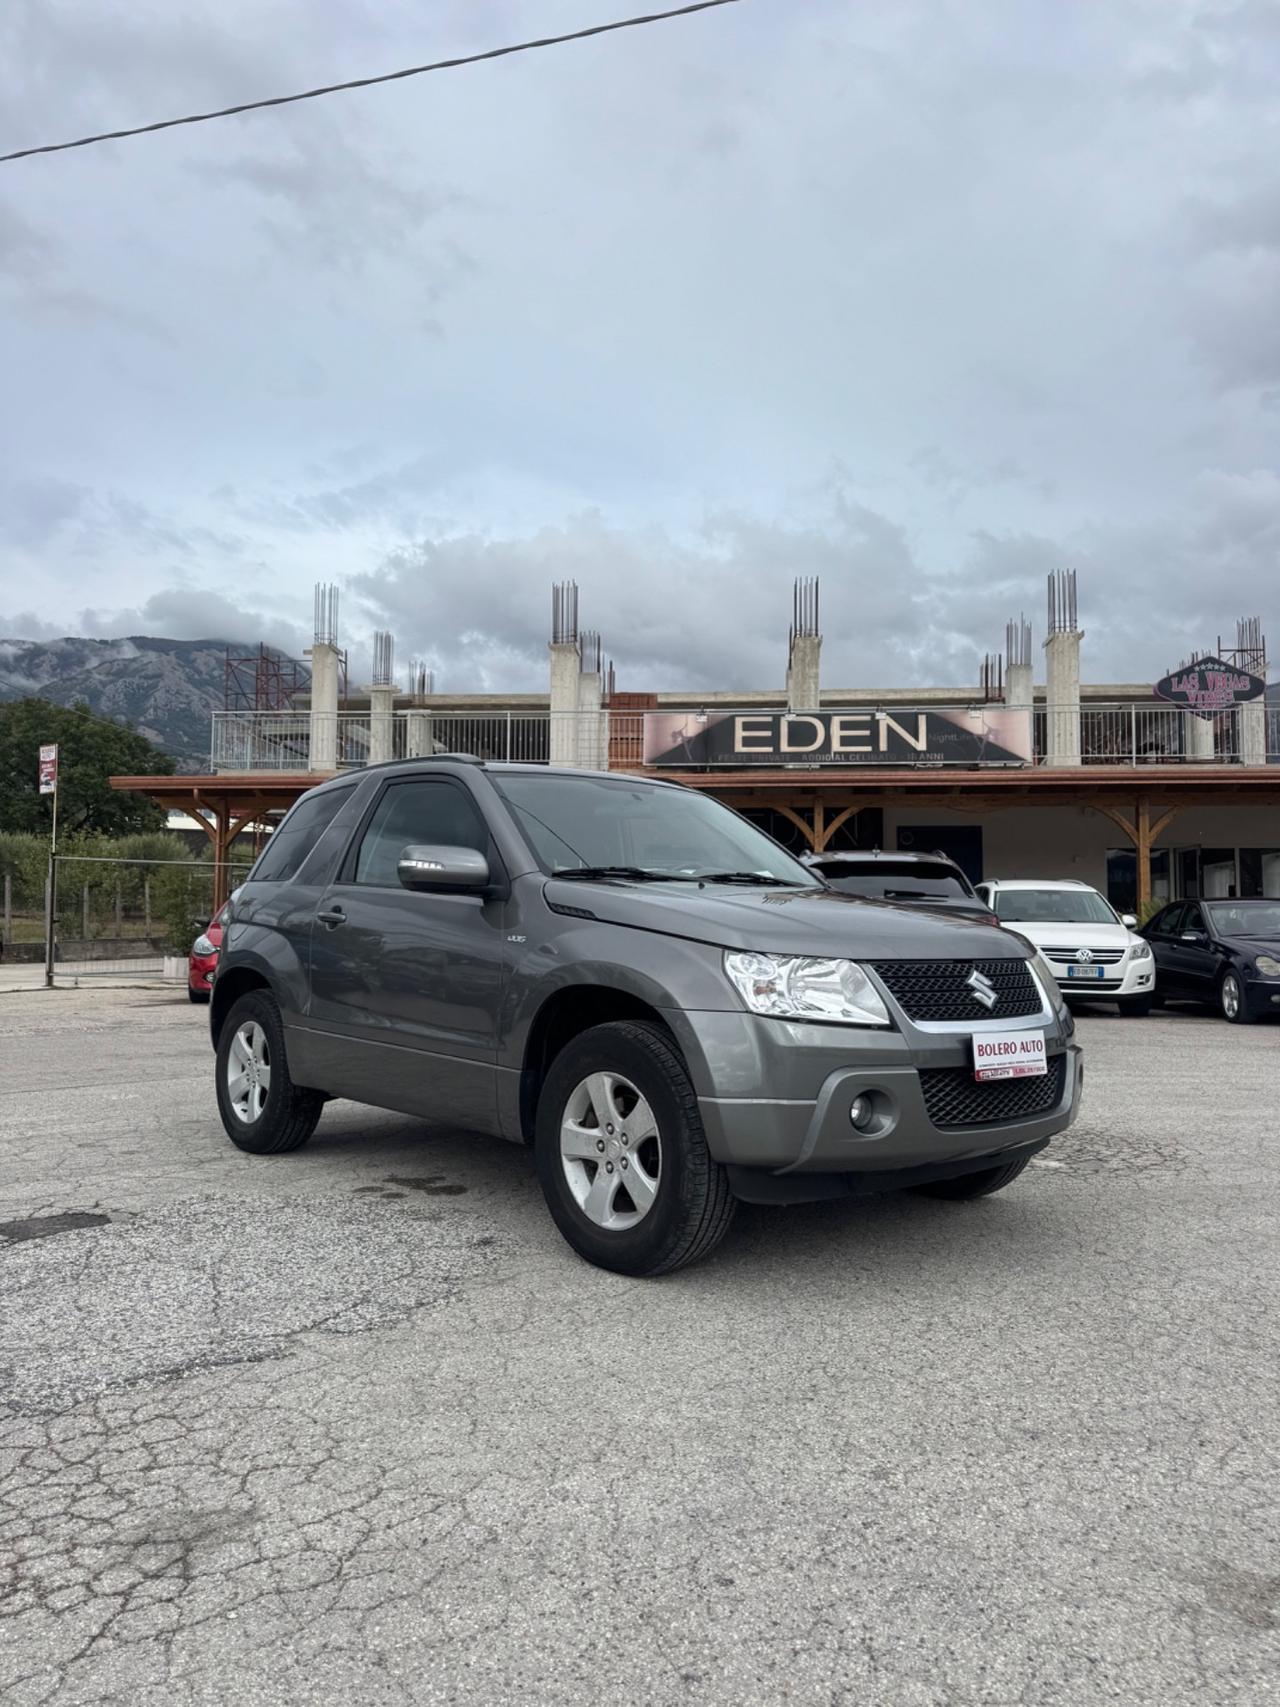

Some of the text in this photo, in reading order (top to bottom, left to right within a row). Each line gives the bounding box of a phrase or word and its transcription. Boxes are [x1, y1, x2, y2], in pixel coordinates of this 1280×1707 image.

[1170, 670, 1251, 692] LAS VEGAS
[734, 714, 927, 753] EDEN
[977, 1039, 1043, 1057] BOLERO AUTO
